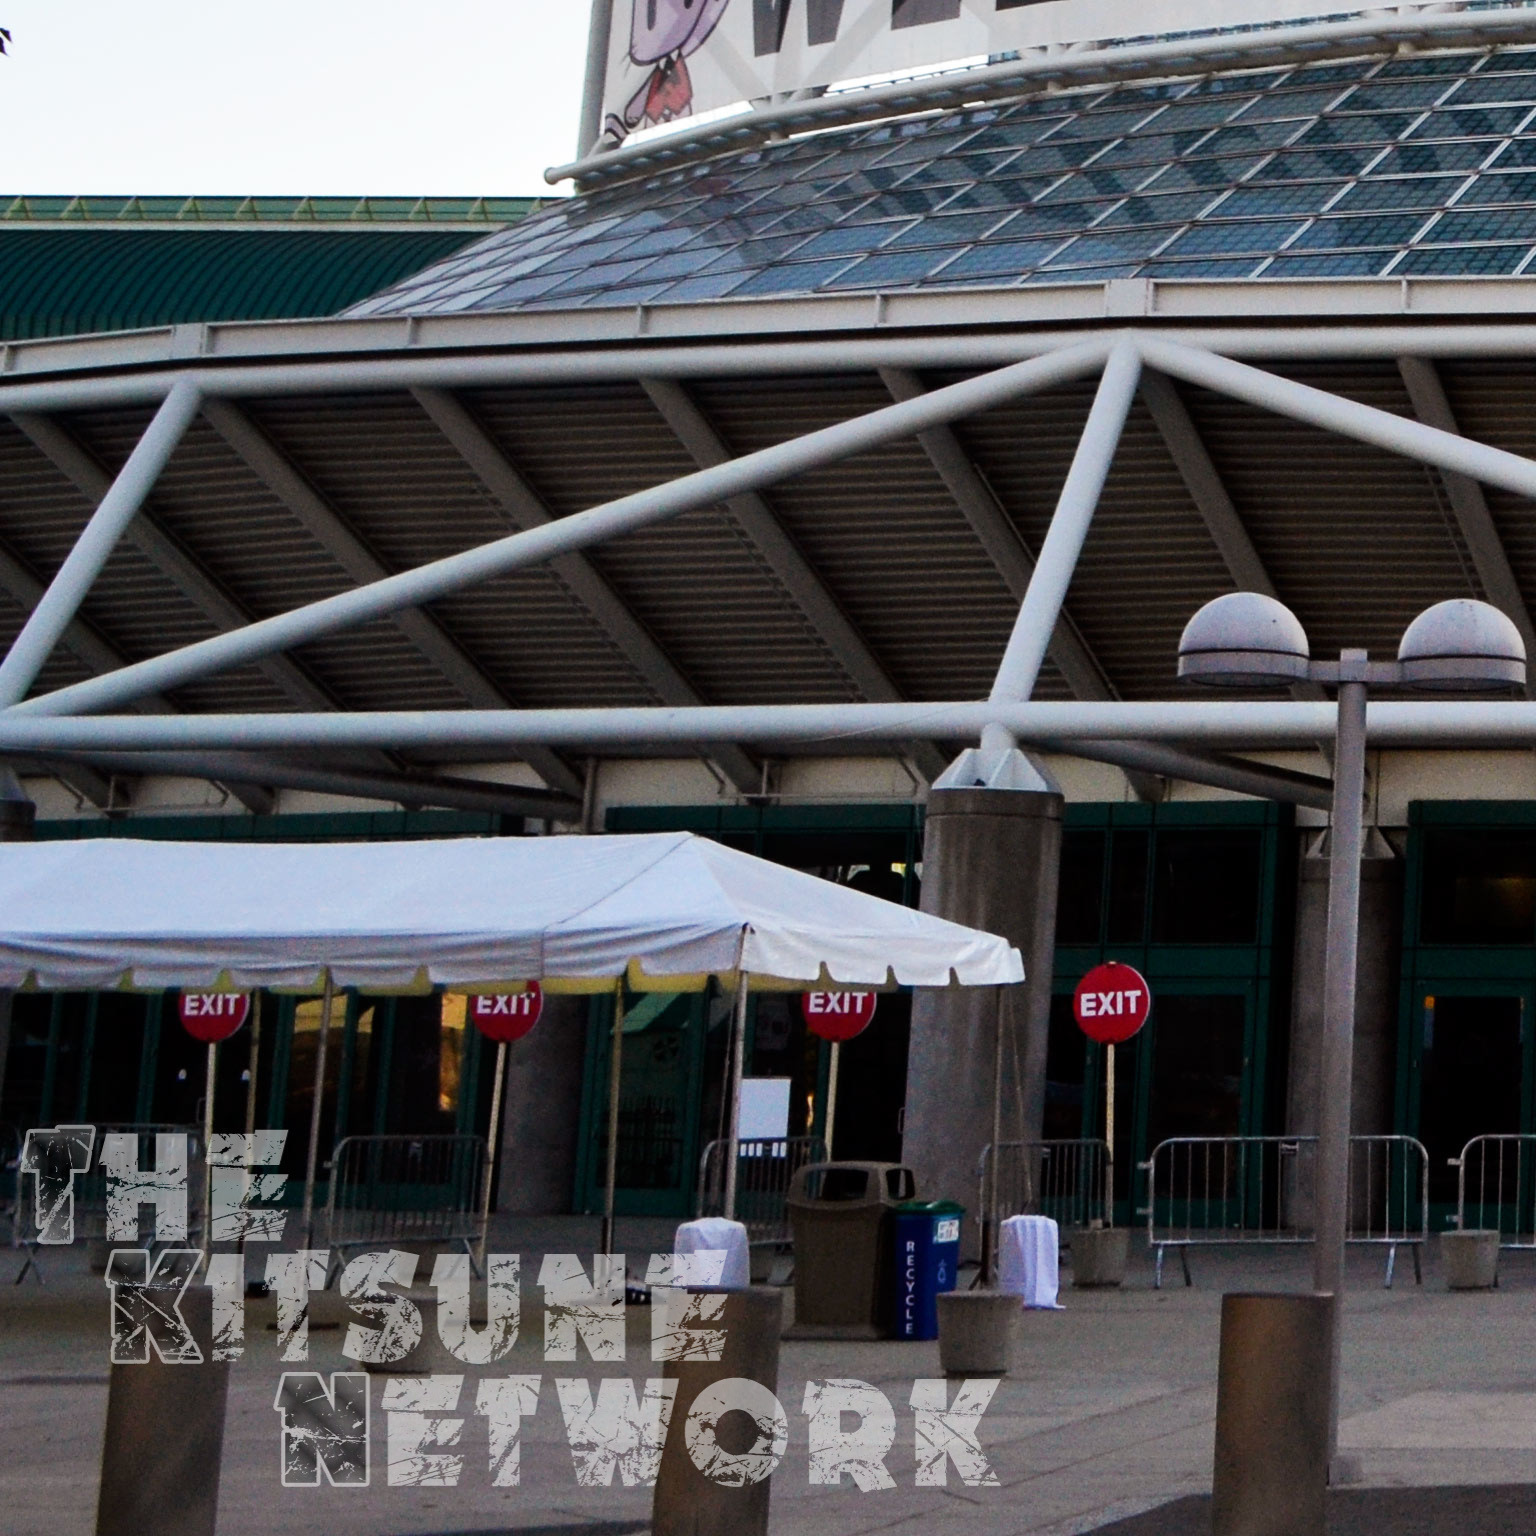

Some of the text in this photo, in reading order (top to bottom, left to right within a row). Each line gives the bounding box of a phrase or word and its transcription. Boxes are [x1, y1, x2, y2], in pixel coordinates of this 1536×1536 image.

[184, 993, 241, 1016] EXIT
[477, 993, 535, 1015] EXIT
[808, 992, 868, 1014] EXIT
[1080, 990, 1141, 1017] EXIT
[906, 1241, 915, 1334] RECYCLE
